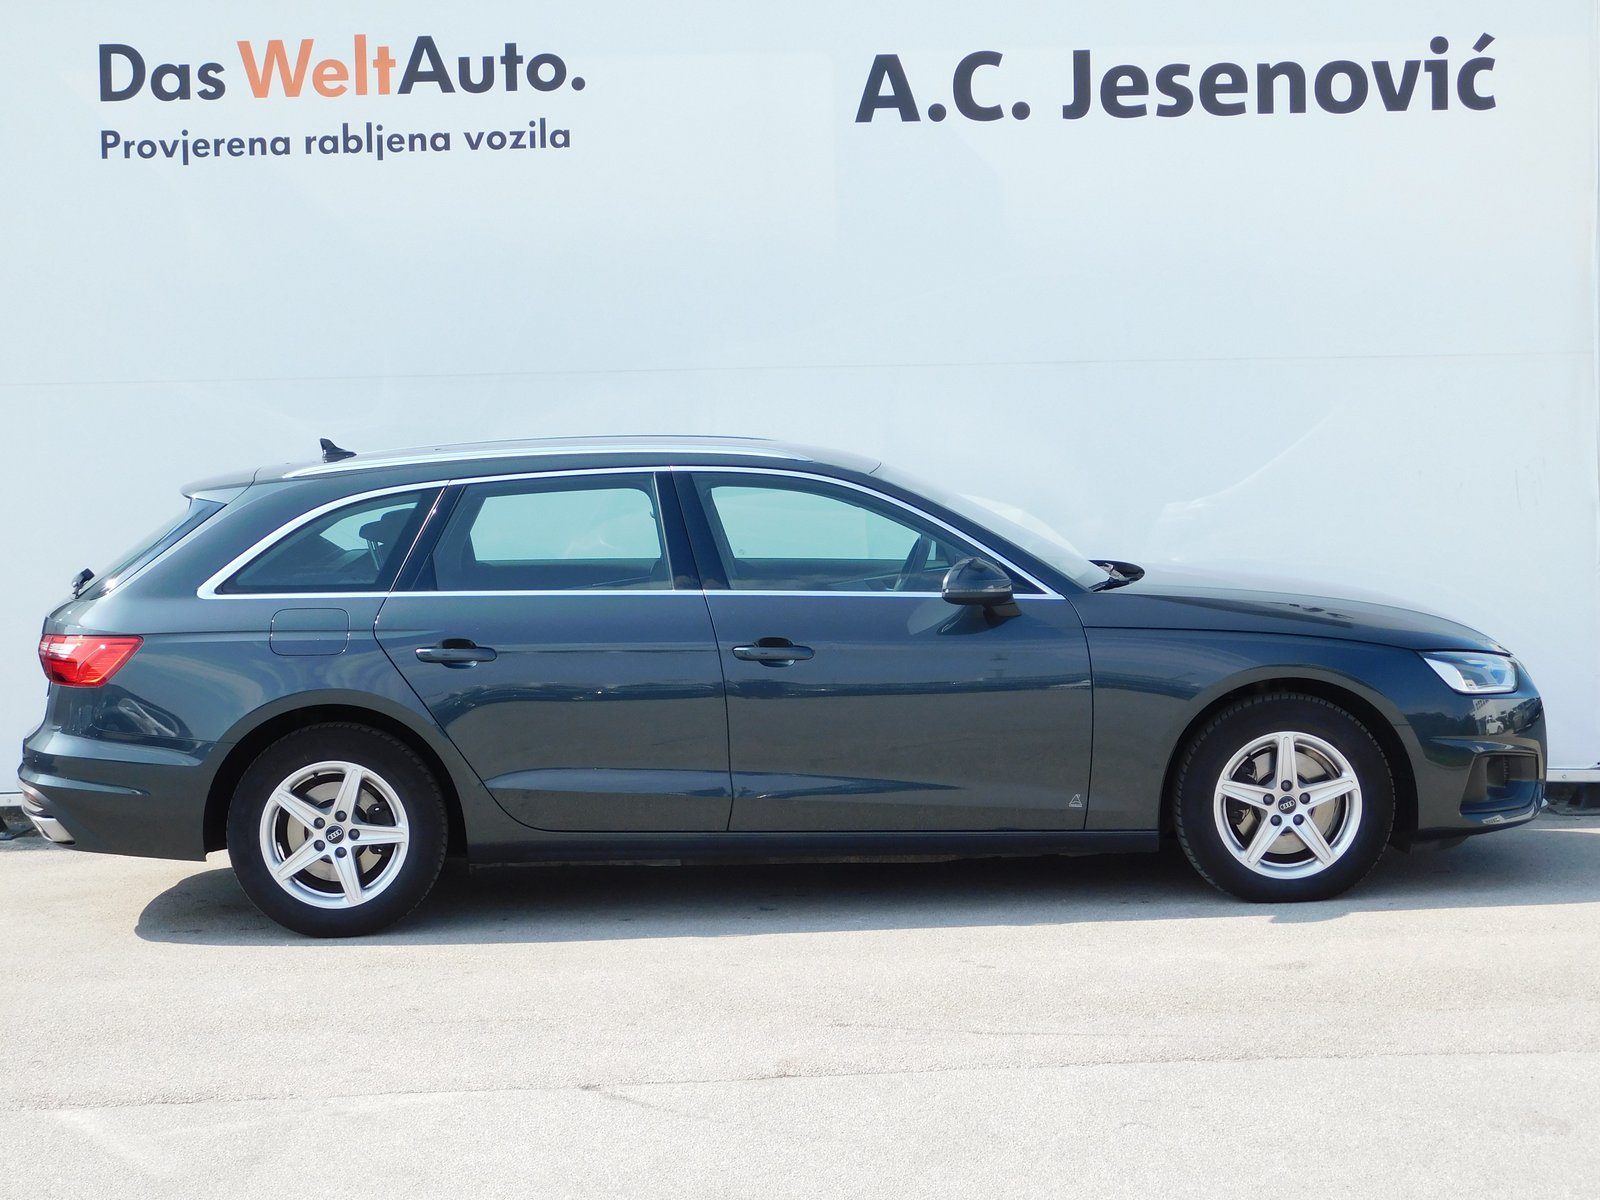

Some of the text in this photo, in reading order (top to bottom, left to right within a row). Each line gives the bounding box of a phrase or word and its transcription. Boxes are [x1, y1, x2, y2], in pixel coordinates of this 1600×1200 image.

[98, 43, 226, 102] Das
[854, 32, 1496, 123] A.C. Jesenović
[100, 116, 571, 166] Provjerena rabljena vozila
